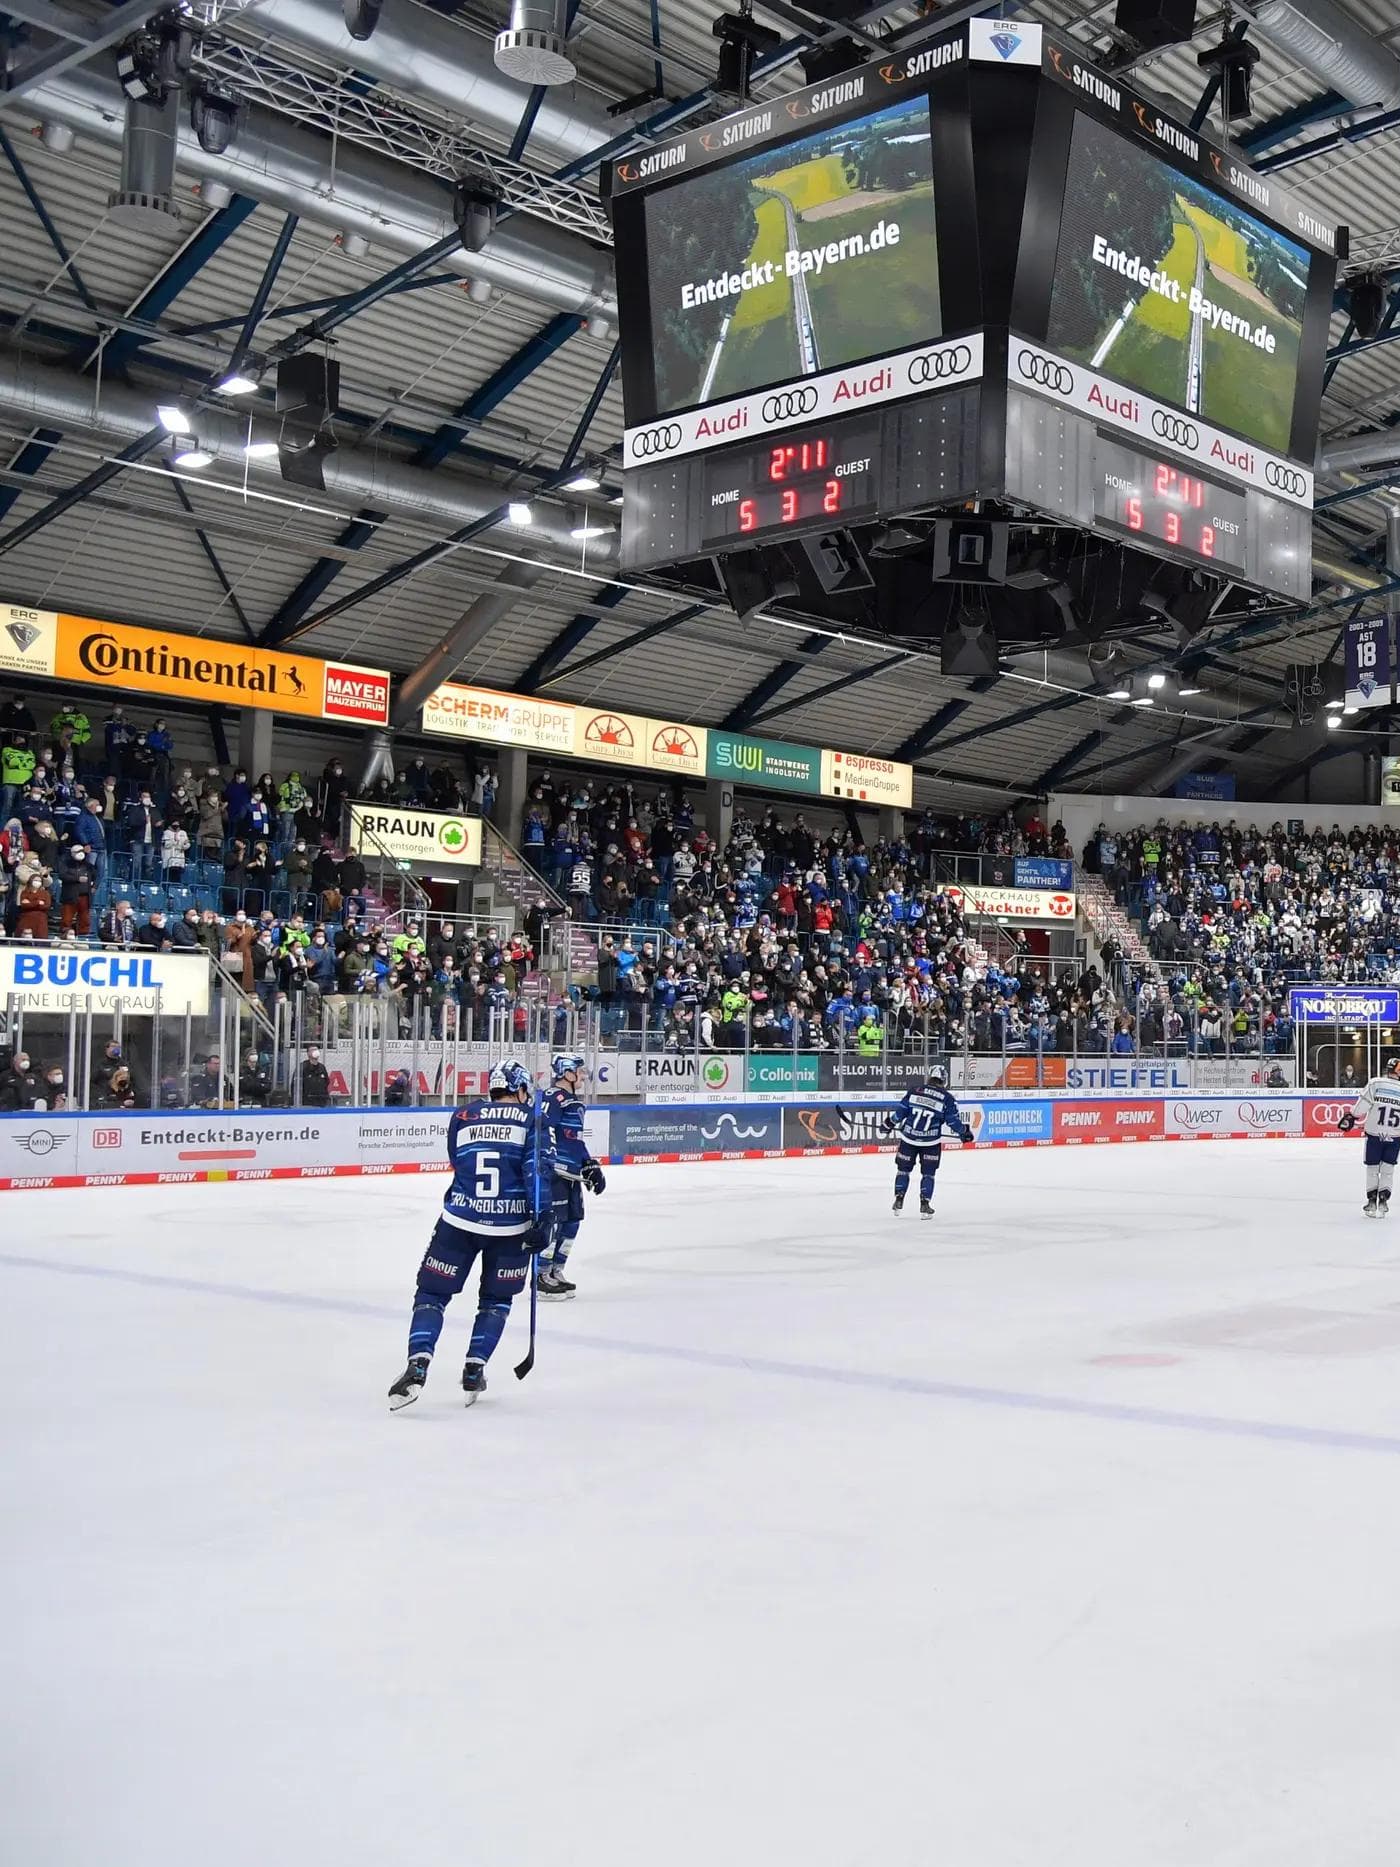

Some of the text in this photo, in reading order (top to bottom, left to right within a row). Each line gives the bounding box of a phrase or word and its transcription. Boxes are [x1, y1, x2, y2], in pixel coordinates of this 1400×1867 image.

[993, 21, 1018, 31] ERC
[906, 39, 963, 77] SATURN
[811, 77, 864, 114] SATURN
[1072, 64, 1121, 112] SATURN
[722, 112, 772, 146] SATURN
[1155, 118, 1199, 161] SATURN
[639, 144, 686, 178] SATURN
[1230, 166, 1270, 206] SATURN
[1297, 211, 1335, 248] SATURN
[682, 220, 900, 309] Entdeckt-Bayern.de
[1092, 235, 1276, 355] Entdeckt-Bayern.de
[833, 367, 892, 403] Audi
[1087, 383, 1139, 423] Audi
[695, 407, 748, 440] Audi
[835, 458, 871, 477] GUEST
[1210, 439, 1255, 475] Audi
[711, 489, 740, 506] HOME
[739, 481, 841, 532] 5 3 2
[1127, 498, 1216, 557] 5 3 2
[1212, 516, 1240, 536] GUEST
[10, 608, 38, 620] ERC
[1359, 631, 1374, 642] AST
[78, 632, 278, 694] Continental
[1356, 641, 1377, 668] 18
[327, 678, 385, 701] MAYER
[327, 696, 385, 712] BAUZENTRUM
[765, 756, 810, 772] STADTWERKE
[765, 767, 810, 781] INGOLSTADT
[846, 754, 894, 774] espresso
[844, 772, 900, 793] MedienGruppe
[722, 791, 732, 808] D
[363, 815, 435, 838] BRAUN
[572, 871, 591, 883] 55
[1017, 876, 1062, 886] PANTHER!
[974, 890, 1041, 903] BACKHAUS
[974, 900, 1040, 915] Hackner
[14, 953, 163, 988] BÜCHL
[760, 1067, 815, 1082] Collomix
[833, 1065, 868, 1076] HELLO!
[869, 1065, 892, 1076] THS
[894, 1065, 903, 1076] IS
[1067, 1069, 1189, 1089] STIEFEL
[480, 1106, 529, 1123] SATURN
[912, 1108, 935, 1131] 77
[988, 1110, 1043, 1125] BODYCHECK
[1377, 1105, 1400, 1128] 15
[96, 1131, 119, 1147] DB
[141, 1127, 320, 1145] Entdeckt-Bayern.de
[359, 1125, 427, 1138] Immer in den
[469, 1124, 512, 1142] WAGNER
[475, 1151, 501, 1199] 5
[425, 1255, 459, 1277] CINQUE
